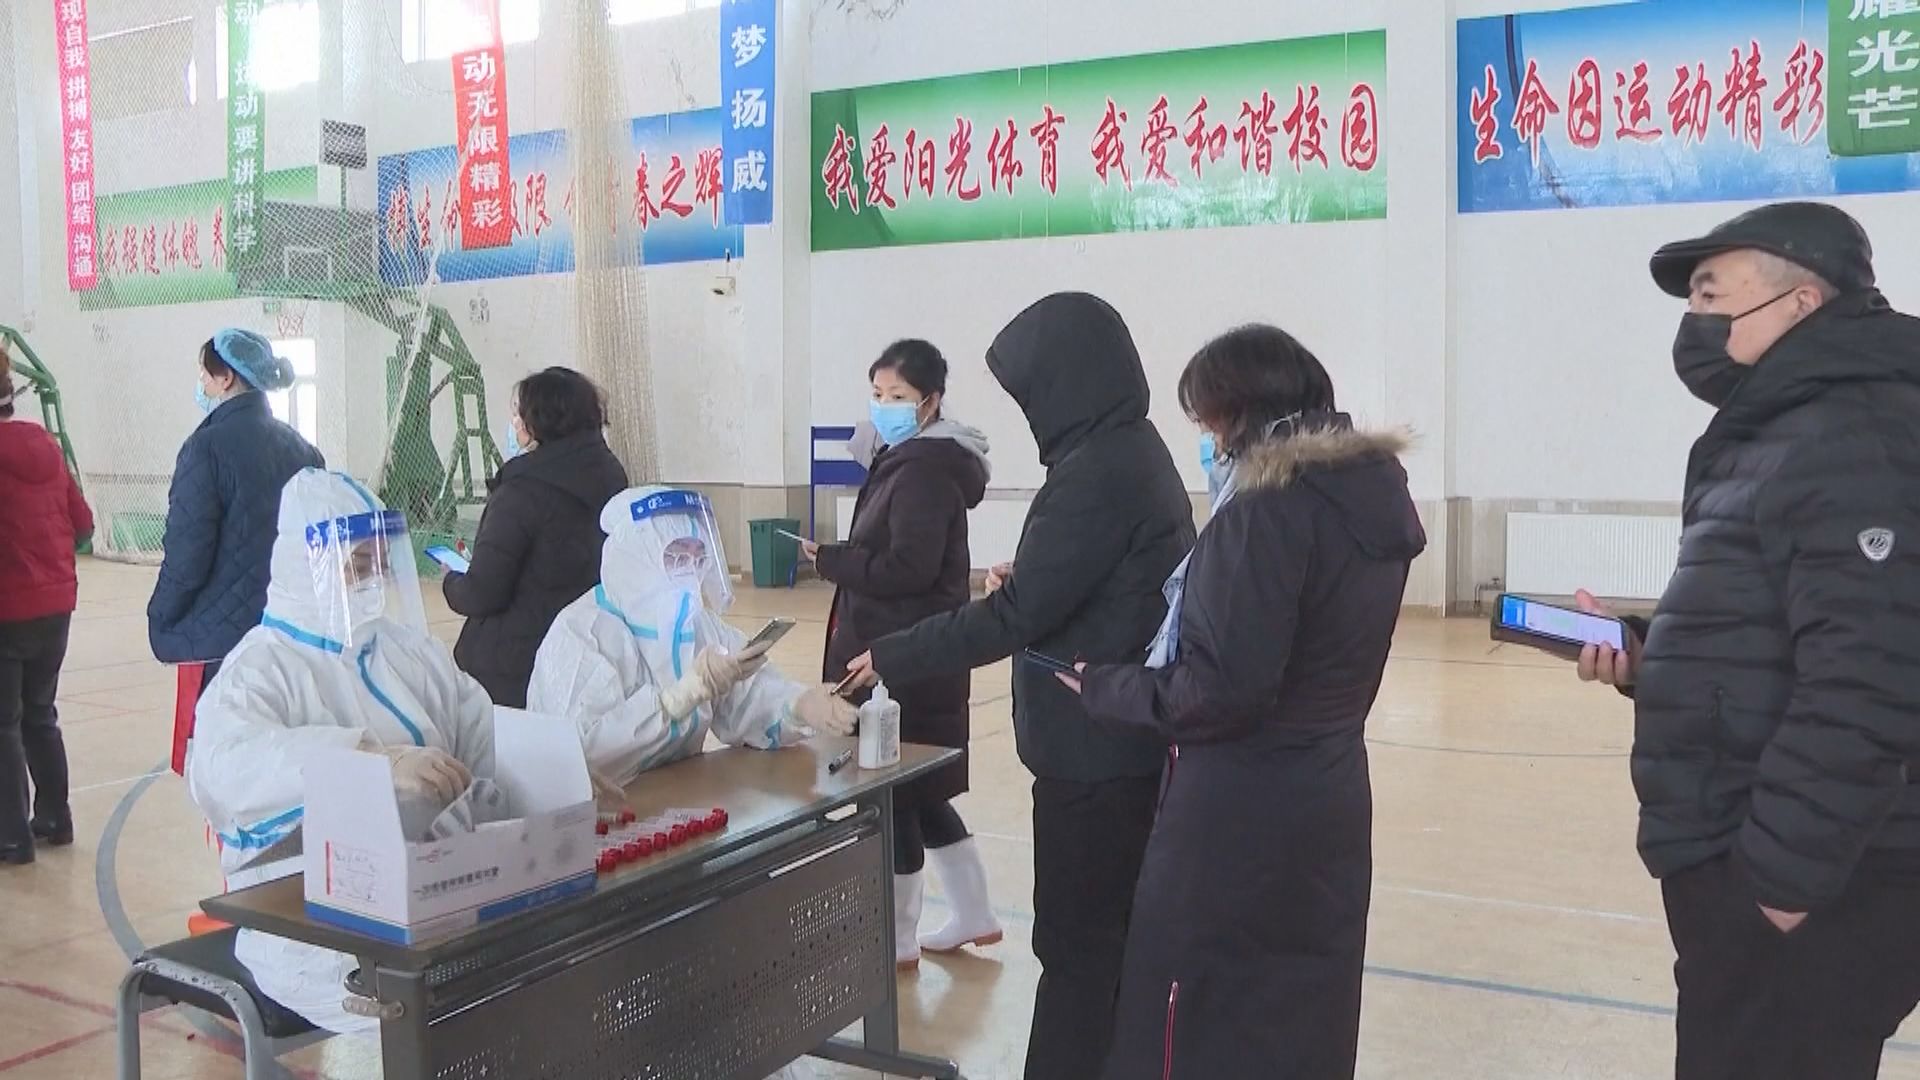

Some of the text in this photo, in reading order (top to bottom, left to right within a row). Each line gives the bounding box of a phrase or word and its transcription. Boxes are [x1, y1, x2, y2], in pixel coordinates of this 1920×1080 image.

[234, 0, 259, 26] 动
[60, 0, 94, 278] 现自我 拼搏 友好 团结 沟通
[463, 51, 505, 230] 动无限精彩
[730, 0, 768, 194] 梦扬威
[821, 81, 1380, 214] 我爱阳光体育 我爱和谐校园
[1470, 39, 1825, 166] 生命因运动精彩
